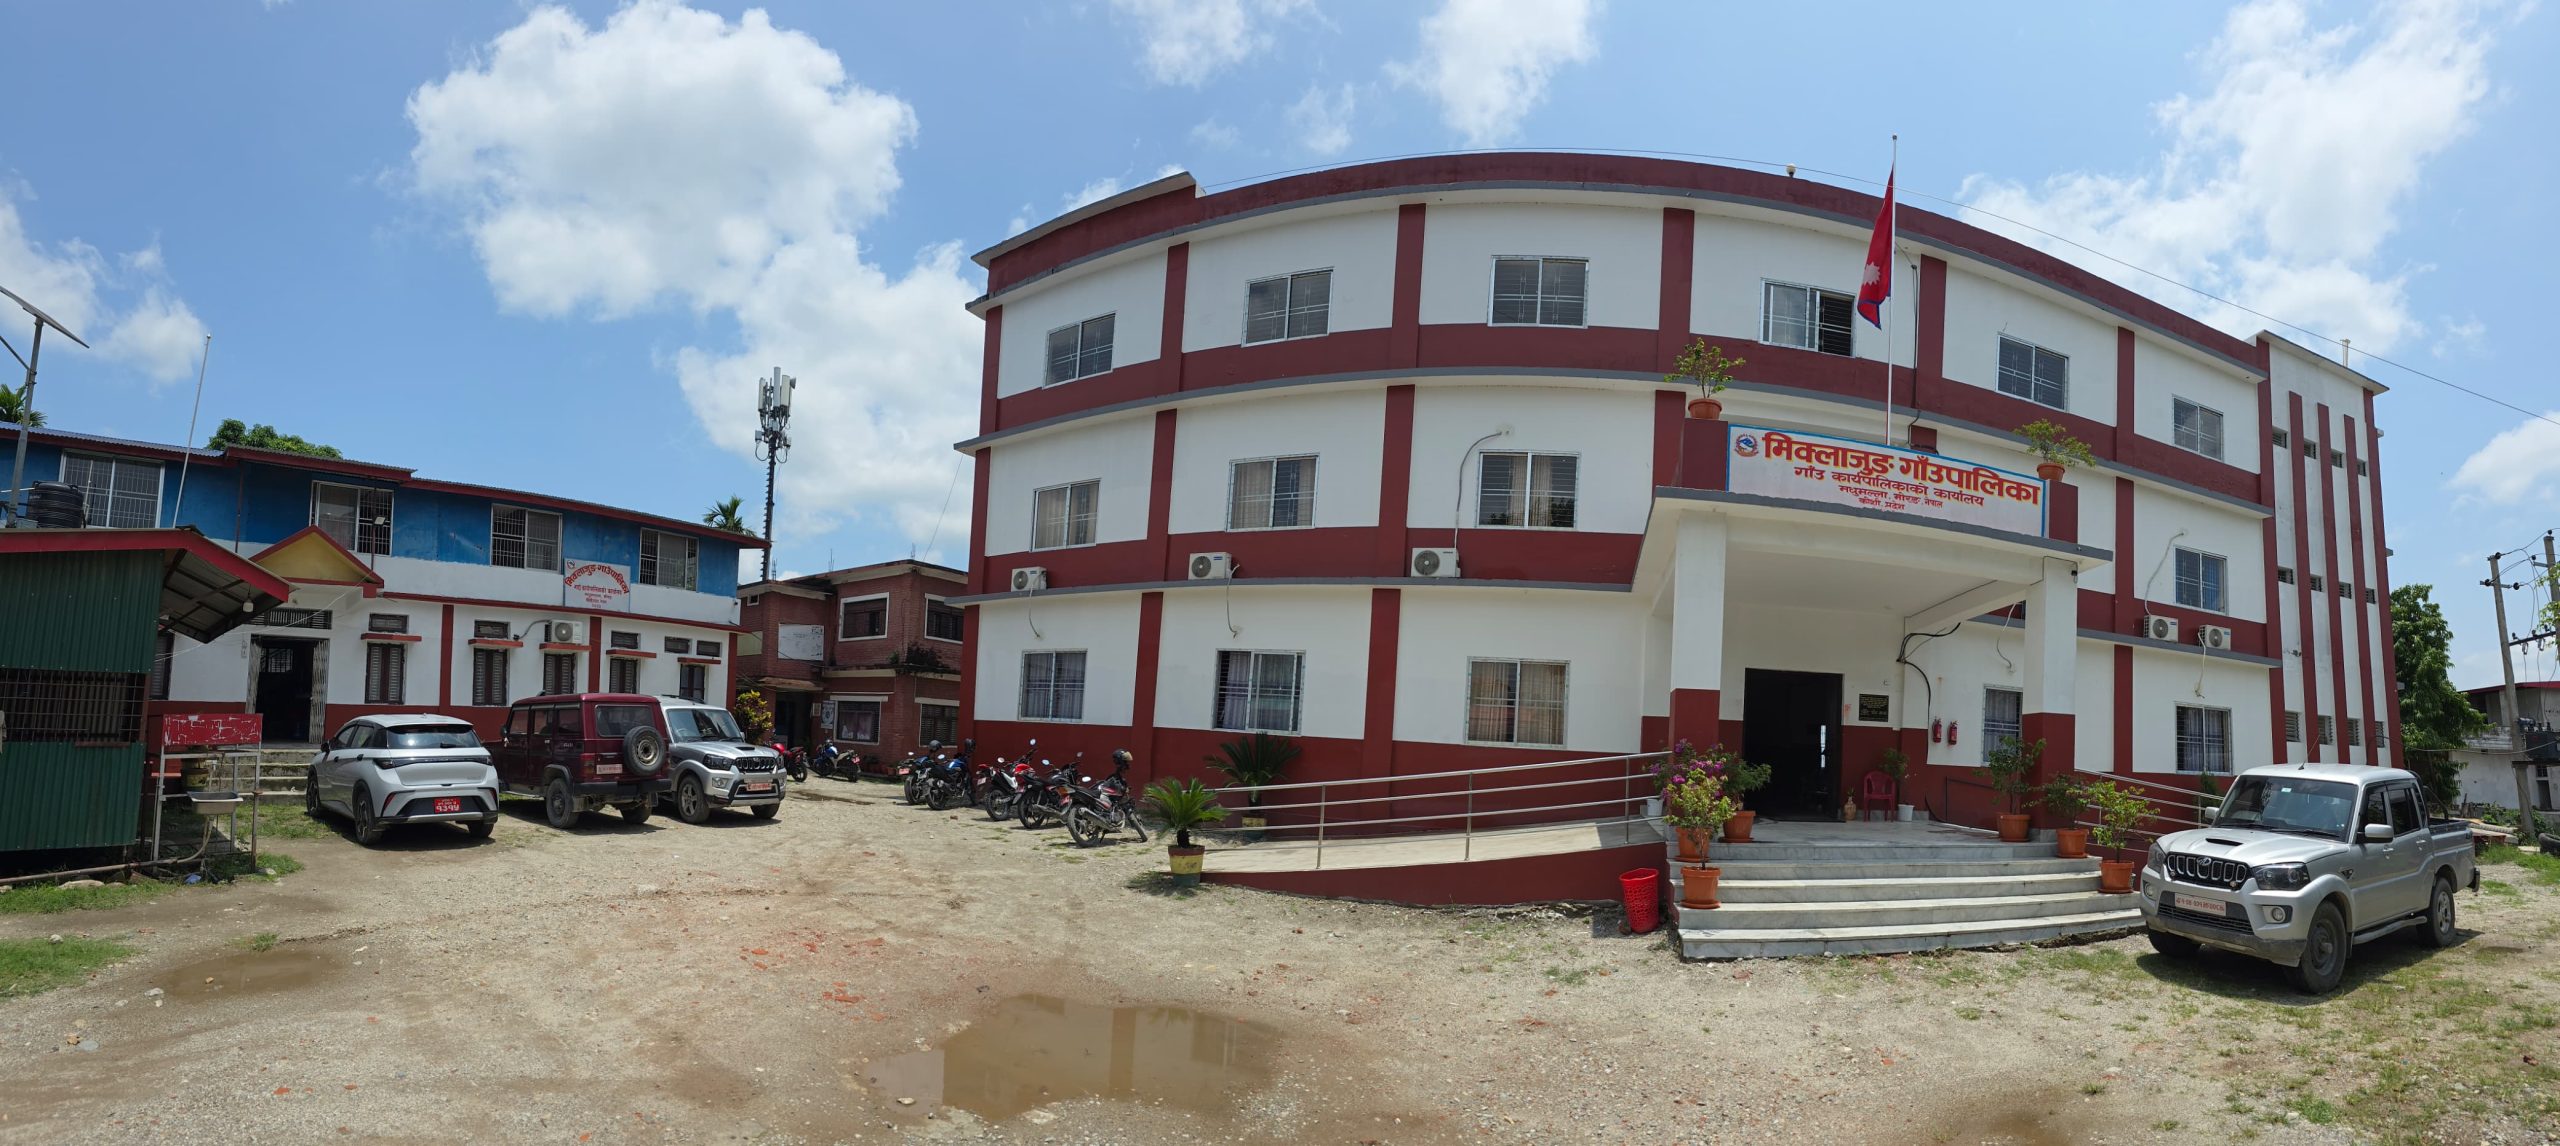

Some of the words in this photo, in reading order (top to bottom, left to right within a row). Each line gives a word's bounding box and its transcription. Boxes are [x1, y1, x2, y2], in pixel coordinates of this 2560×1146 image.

[1762, 432, 1894, 476] मिक्लाजुङ
[1899, 455, 2041, 505] गाँउपालिका
[1831, 470, 1929, 496] कार्यपालिकाको
[1933, 487, 1985, 506] कार्यालय
